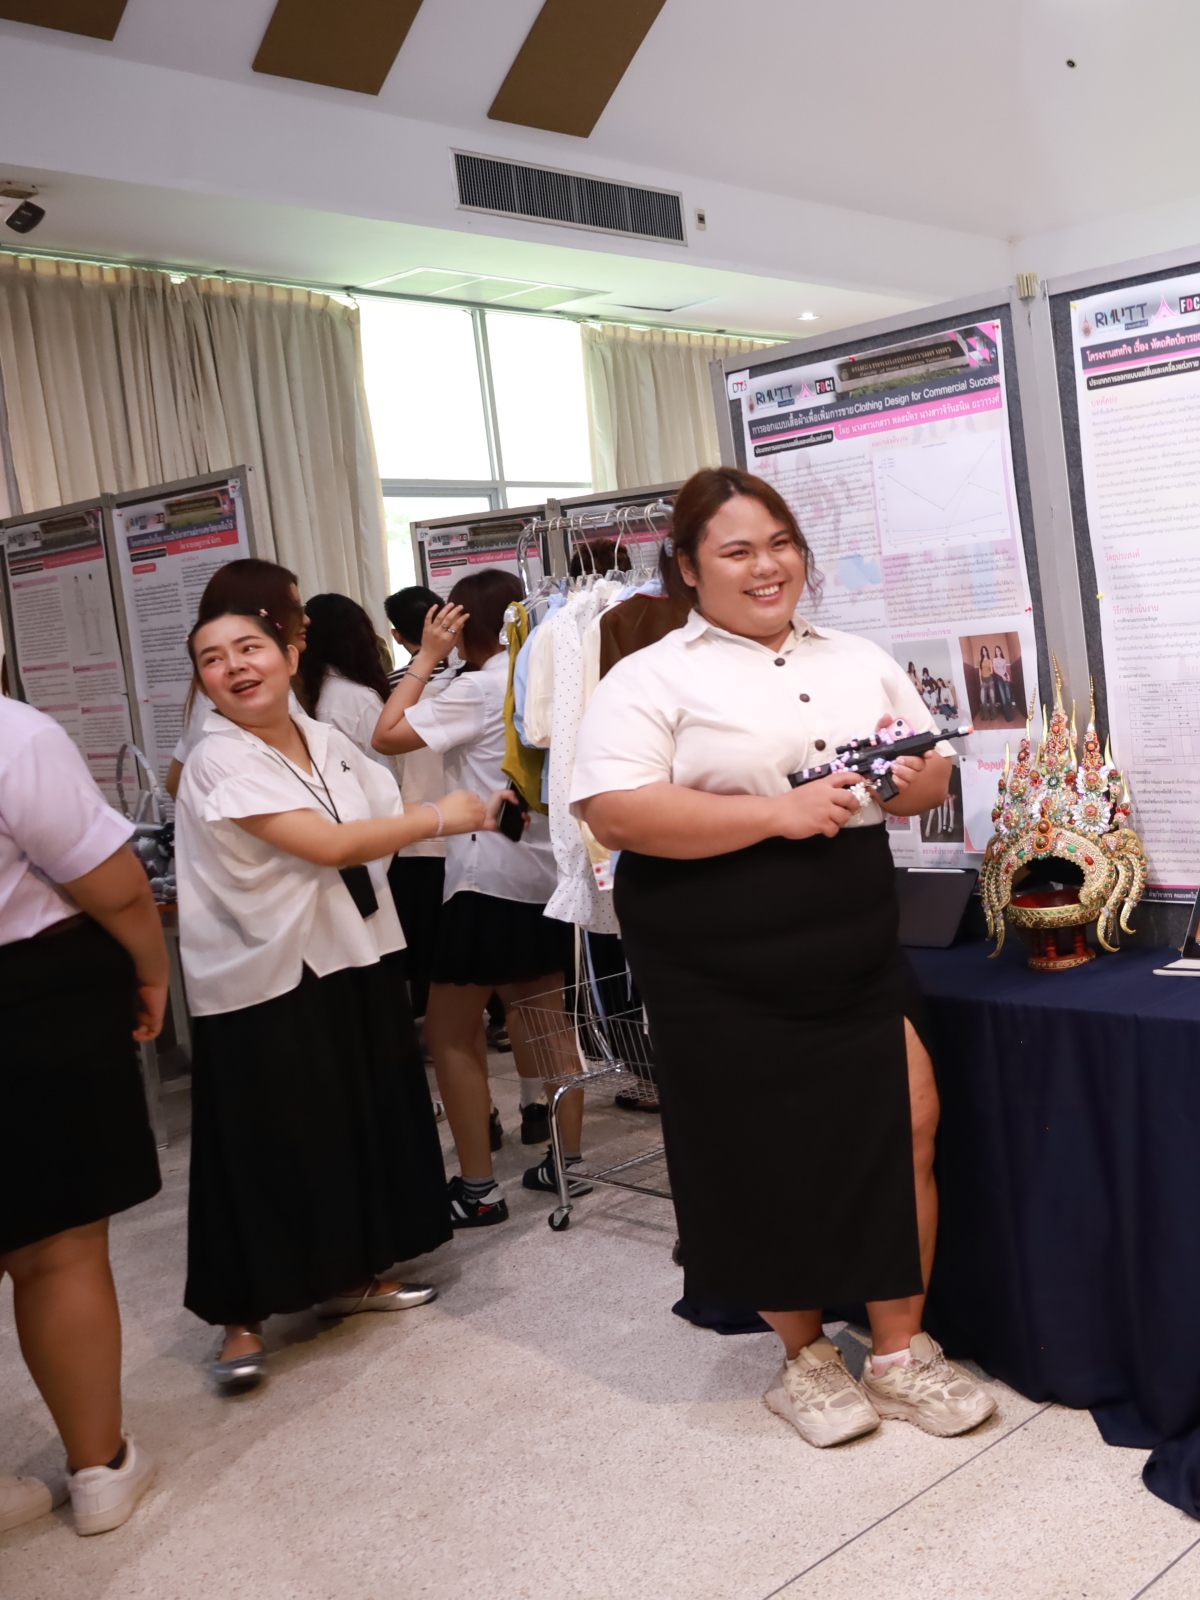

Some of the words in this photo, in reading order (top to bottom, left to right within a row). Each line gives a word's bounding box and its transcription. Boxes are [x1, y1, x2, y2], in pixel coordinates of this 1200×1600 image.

[1094, 302, 1148, 328] RMUTT
[1133, 338, 1149, 354] เรื่อง
[900, 360, 924, 370] Economics
[926, 354, 950, 364] Technology
[732, 380, 748, 393] D13
[816, 379, 834, 393] FDCI
[854, 399, 883, 414] Clothing
[885, 394, 910, 407] Design
[911, 391, 921, 400] for
[923, 380, 968, 399] Commercial
[969, 374, 1001, 389] Success
[755, 384, 793, 405] RMUTT
[838, 424, 851, 436] โดย
